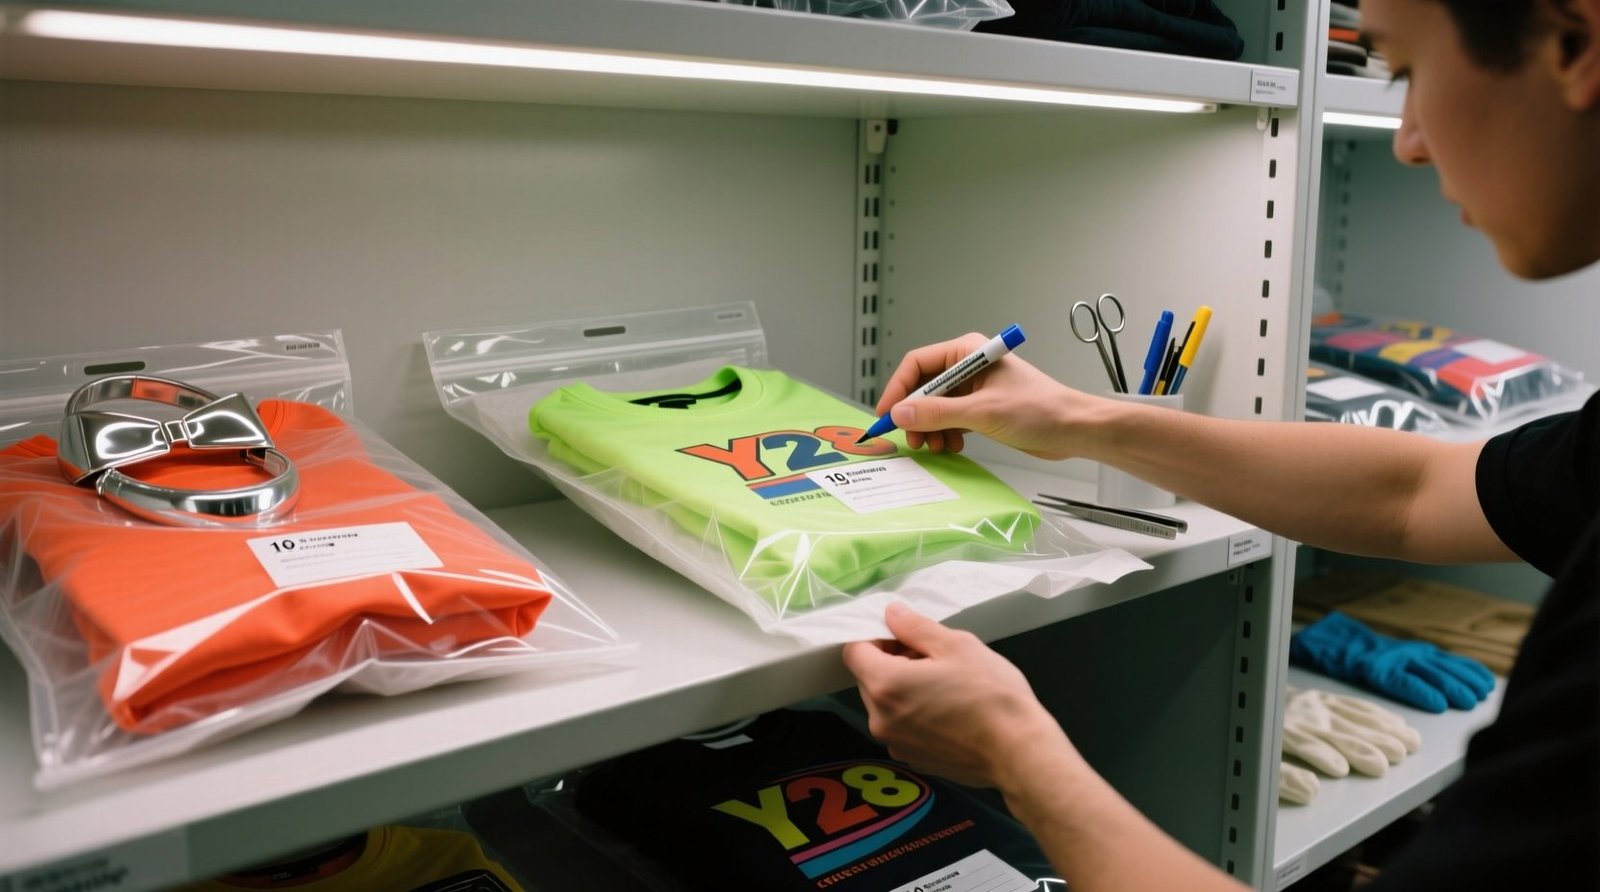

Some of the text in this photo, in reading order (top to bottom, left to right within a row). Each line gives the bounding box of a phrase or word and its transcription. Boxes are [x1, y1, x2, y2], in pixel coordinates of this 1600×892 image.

[674, 425, 898, 482] Y28
[270, 539, 295, 553] 10
[710, 765, 920, 850] Y28
